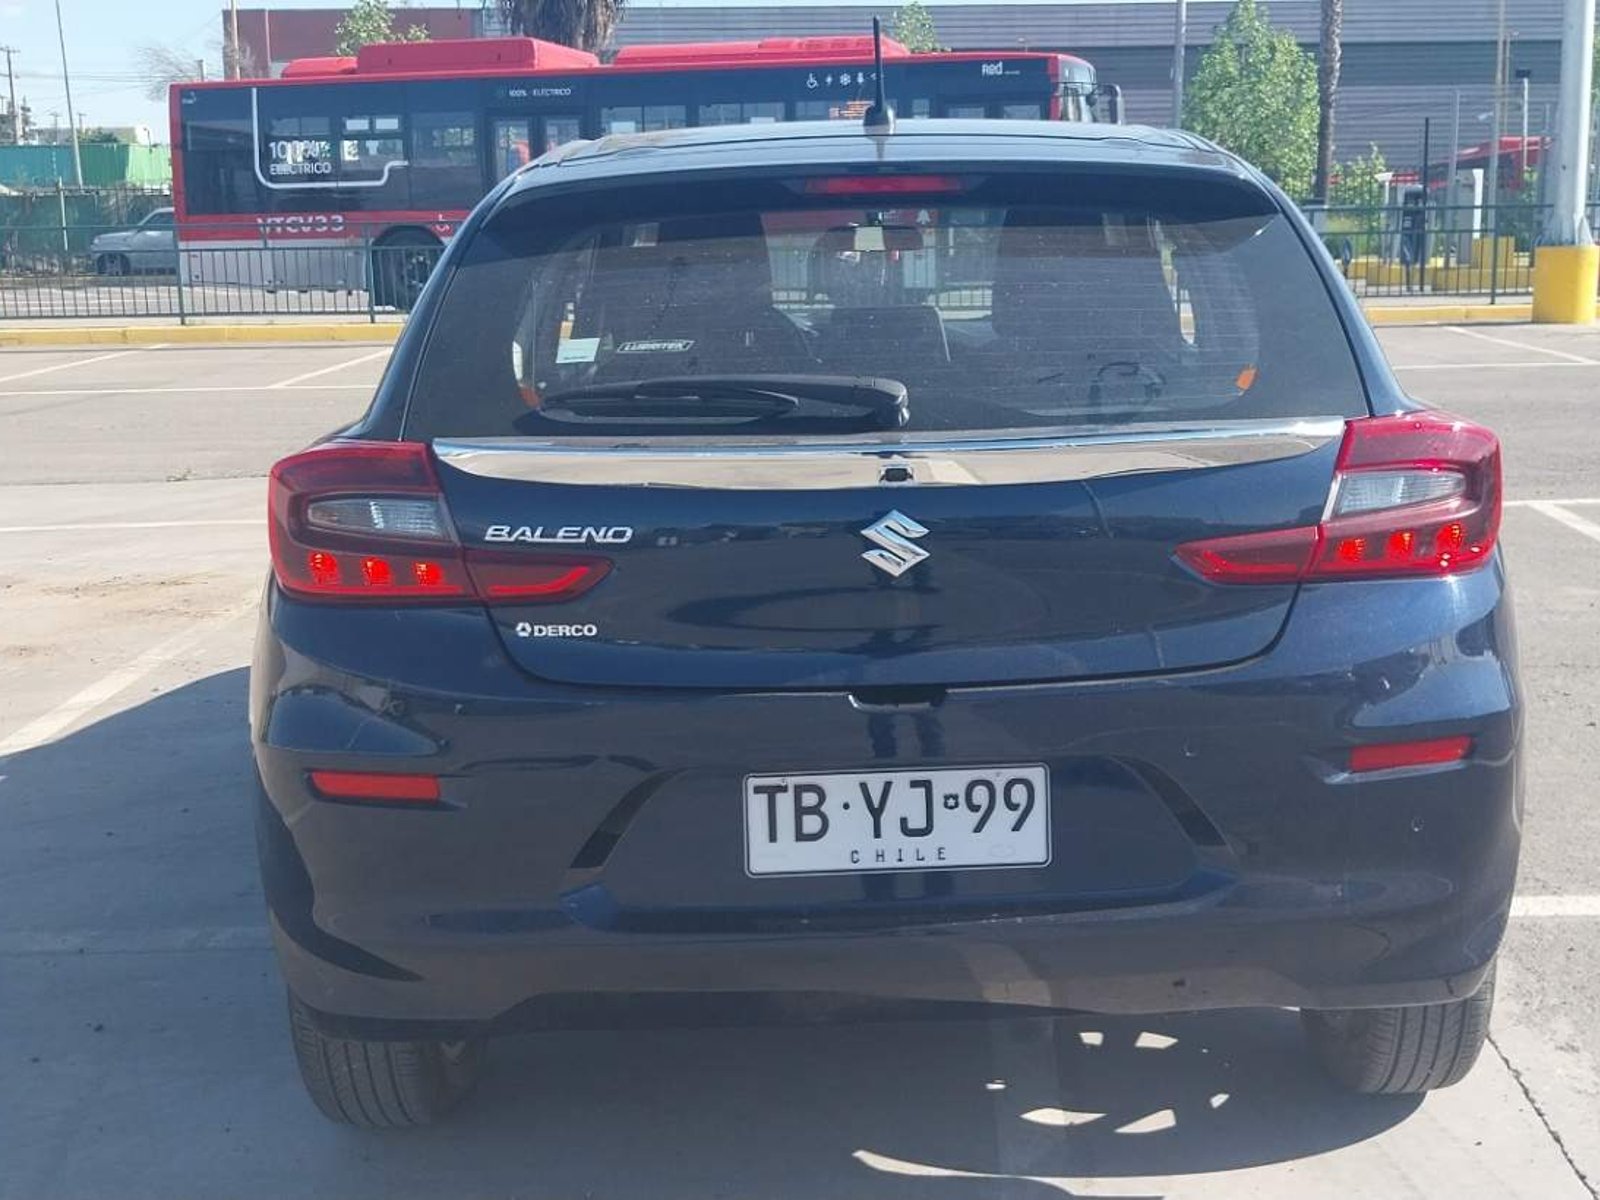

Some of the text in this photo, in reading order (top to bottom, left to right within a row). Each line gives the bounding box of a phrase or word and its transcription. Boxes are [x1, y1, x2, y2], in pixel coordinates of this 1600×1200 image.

[484, 525, 633, 543] BALENO
[533, 624, 598, 637] DERCO
[850, 847, 947, 864] CHILE
